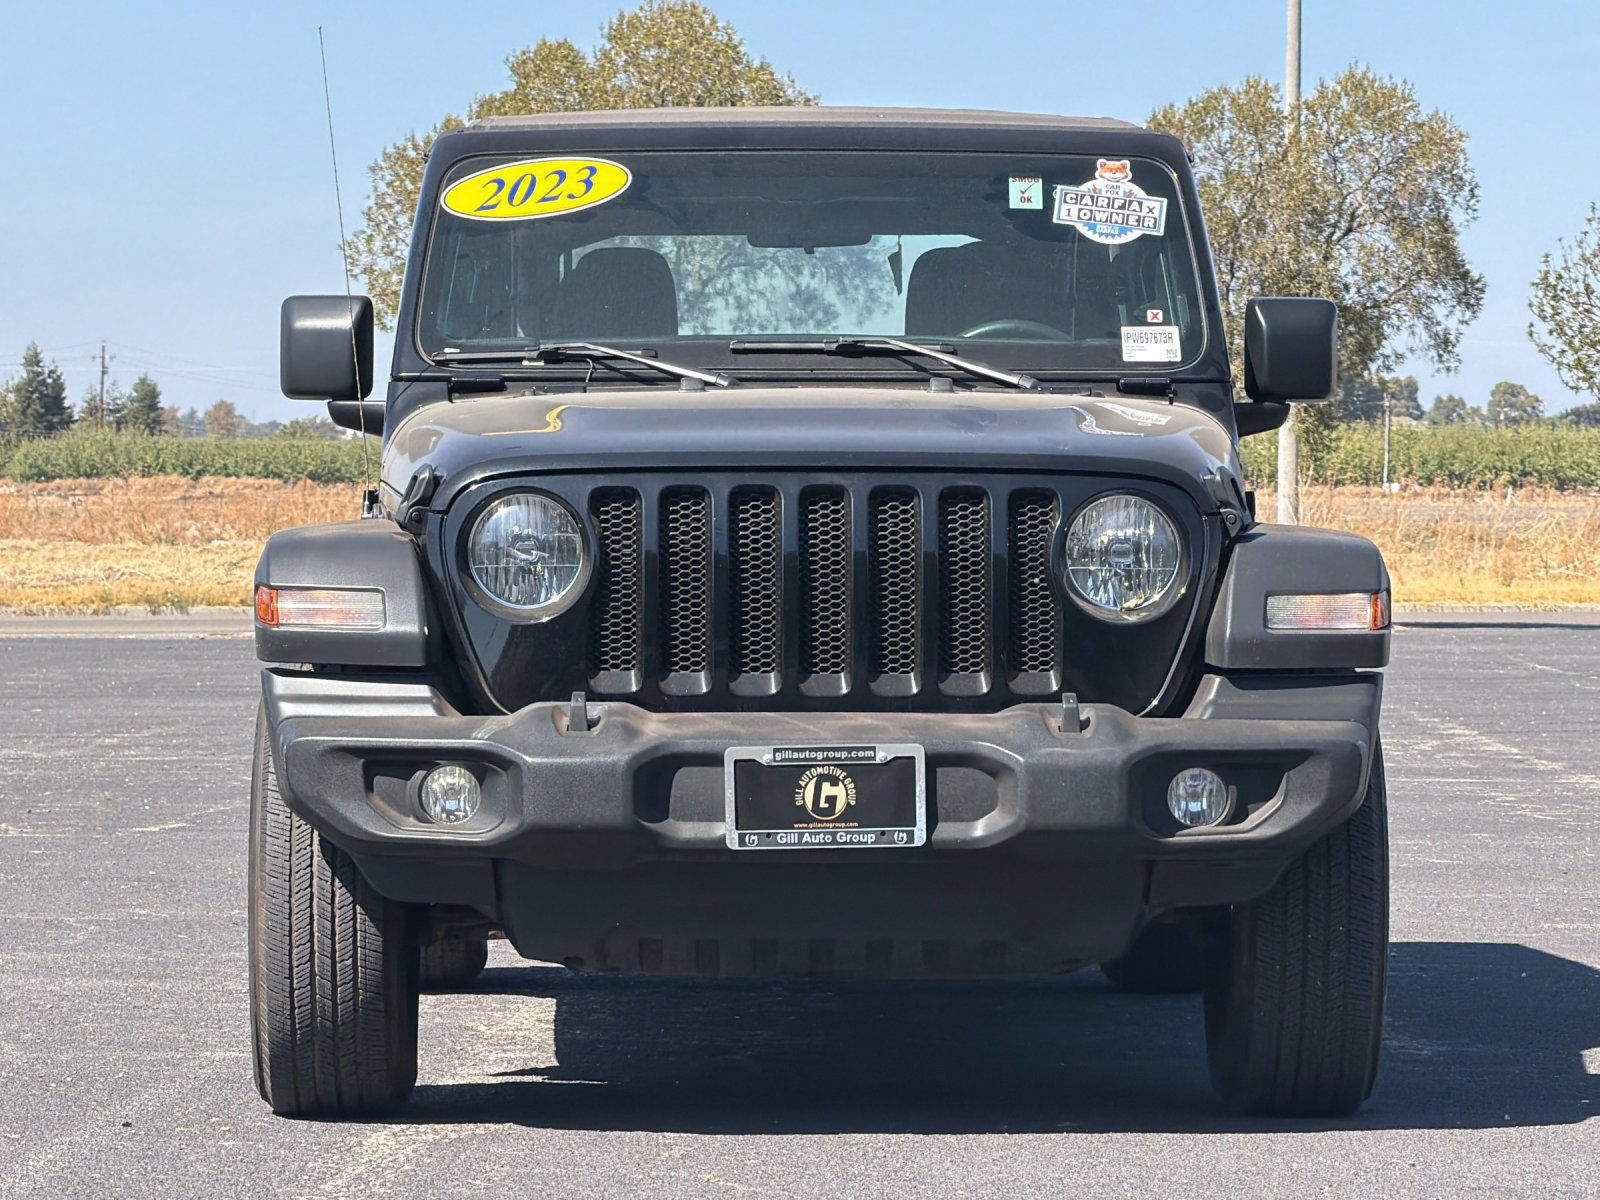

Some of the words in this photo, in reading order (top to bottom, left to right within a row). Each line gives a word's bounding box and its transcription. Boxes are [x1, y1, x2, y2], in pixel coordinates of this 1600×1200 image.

[474, 166, 598, 212] 2023
[1020, 196, 1033, 204] OK
[1064, 193, 1157, 216] CARFAX
[1078, 209, 1157, 229] OWNER
[775, 750, 875, 760] gillautogroup.com
[799, 766, 847, 787] AUTOMOTIVE
[795, 788, 804, 806] GILL
[844, 777, 857, 806] GROUP
[777, 833, 798, 844] Gill
[802, 833, 832, 844] Auto
[836, 832, 876, 844] Group
